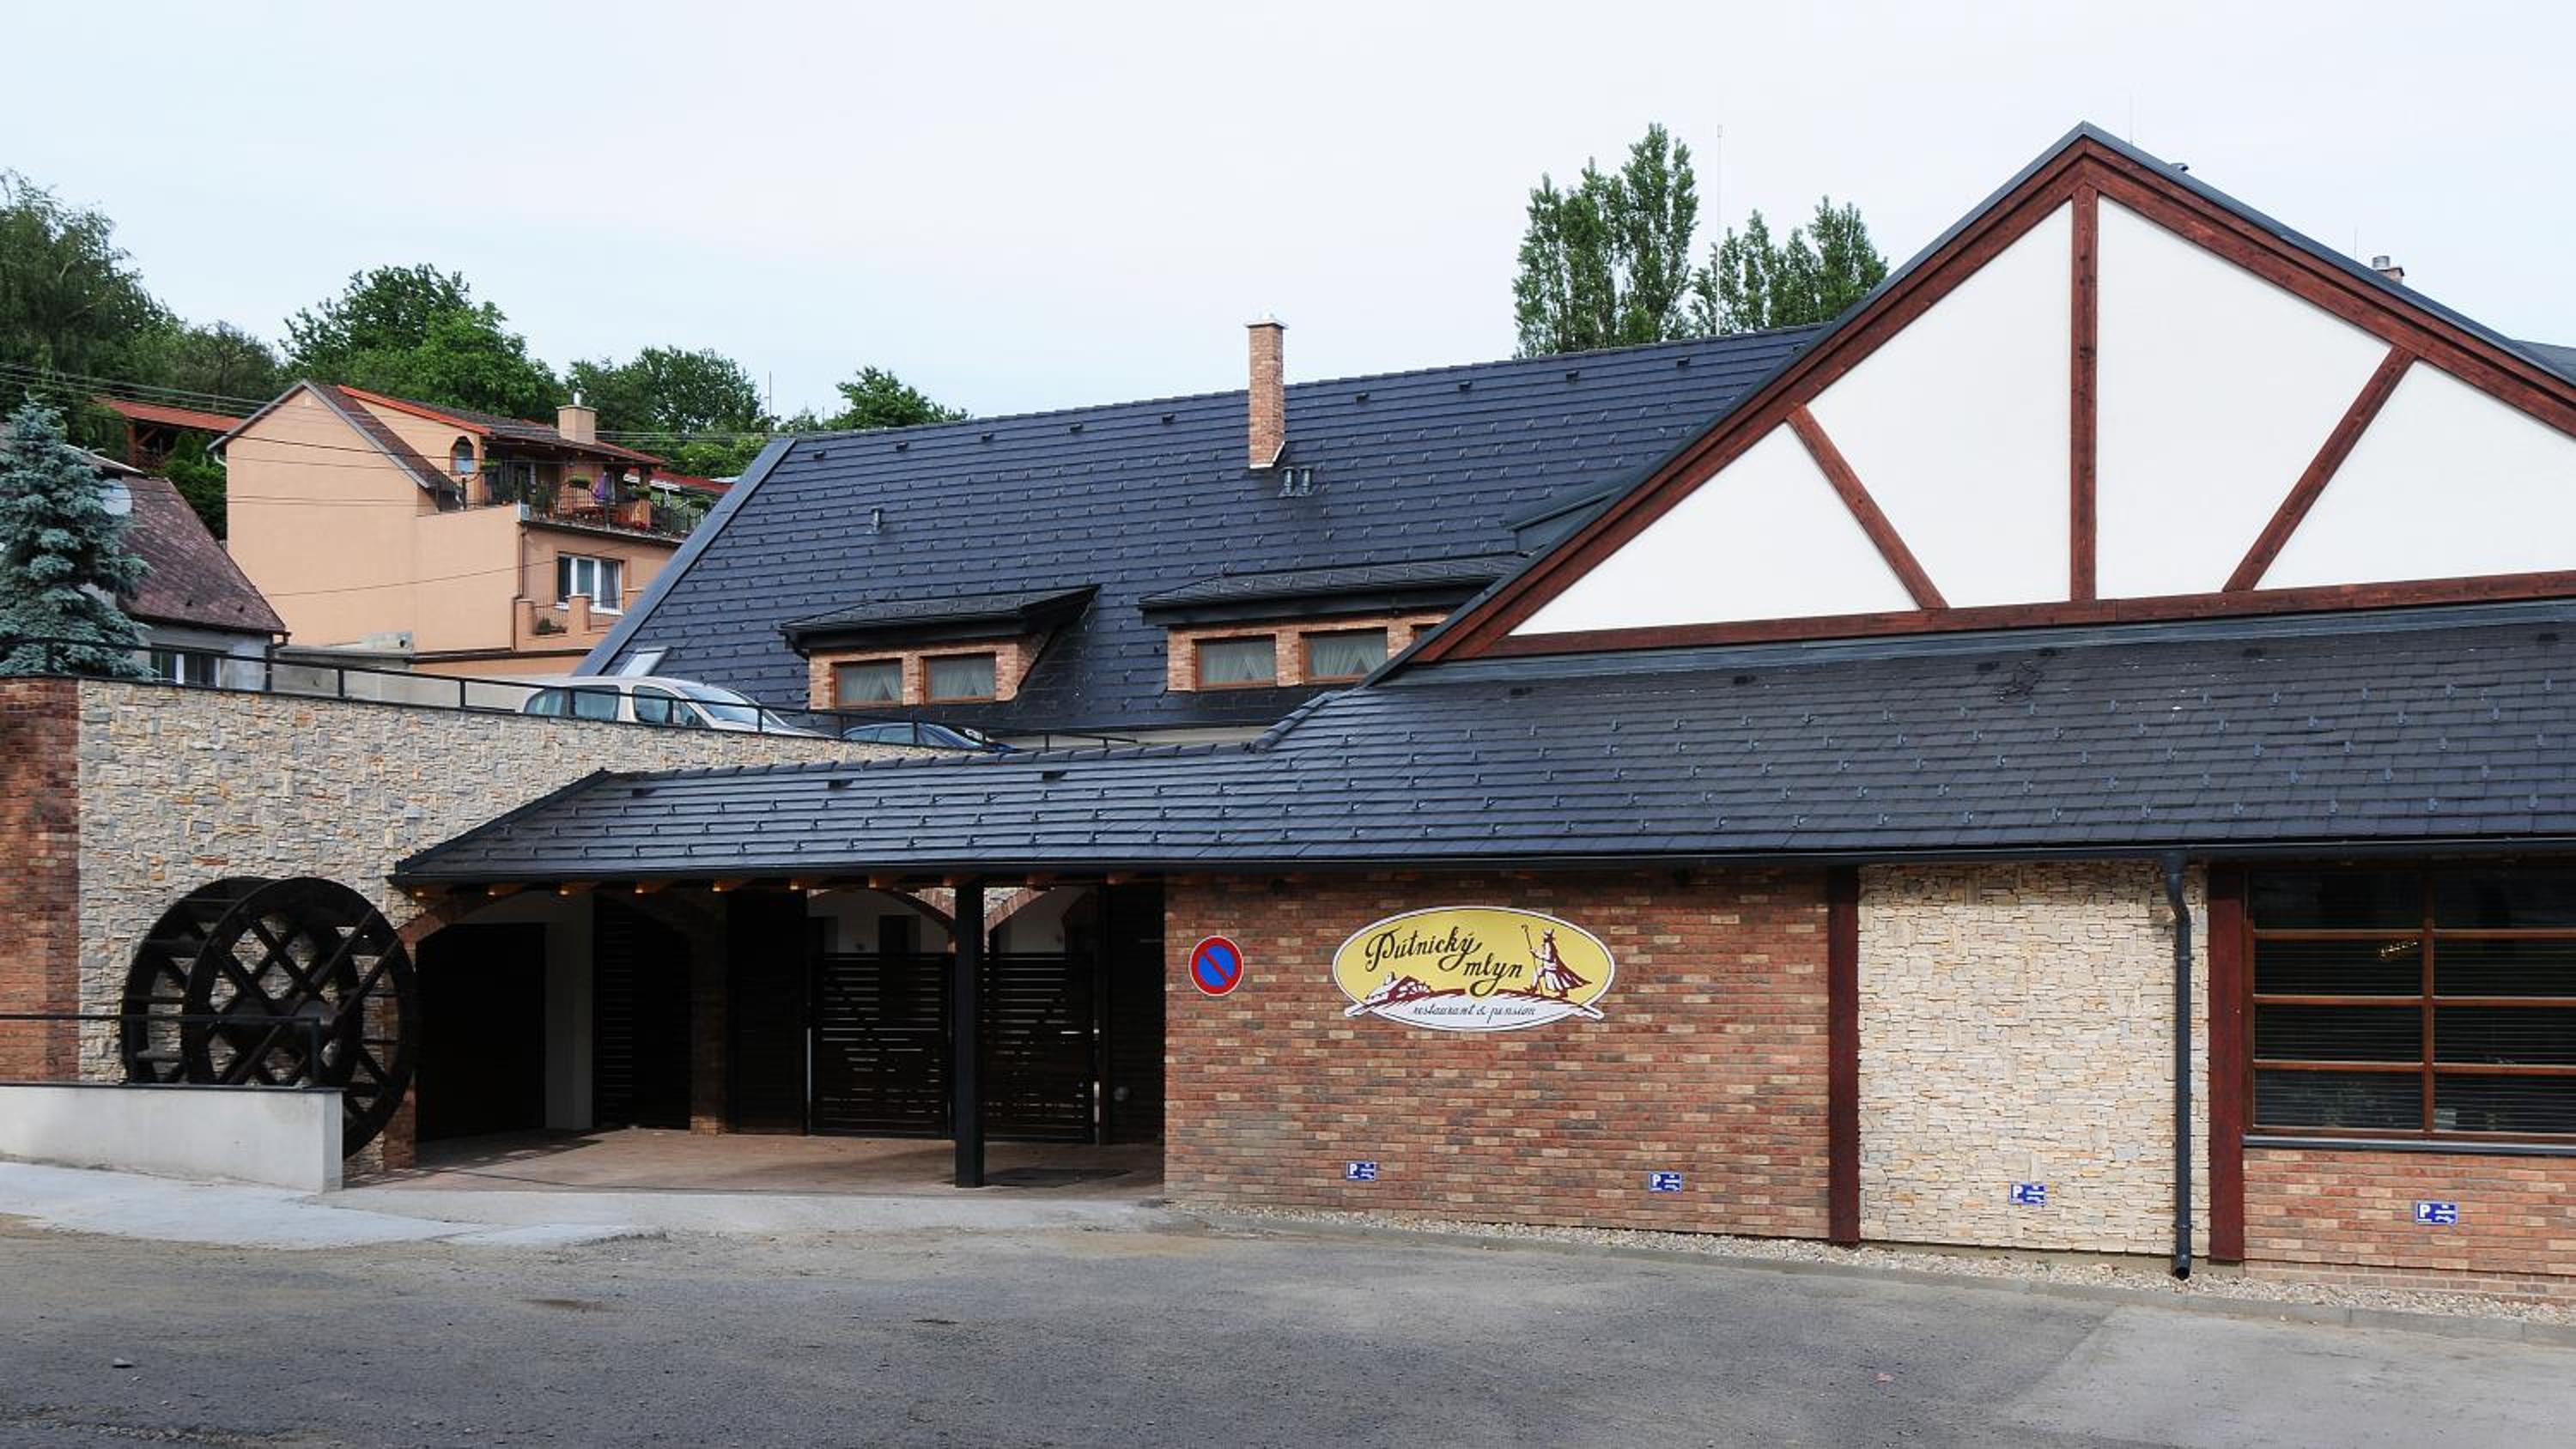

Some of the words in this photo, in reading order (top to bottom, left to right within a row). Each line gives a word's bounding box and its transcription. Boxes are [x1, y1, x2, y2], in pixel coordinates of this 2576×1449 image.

[1462, 952, 1522, 997] mlyn
[1413, 1003, 1476, 1016] restaurant
[1476, 1005, 1486, 1016] &
[1486, 1004, 1536, 1024] pension
[1350, 1163, 1358, 1175] P
[1652, 1173, 1662, 1186] P
[2012, 1185, 2023, 1198] P
[2419, 1204, 2431, 1218] P
